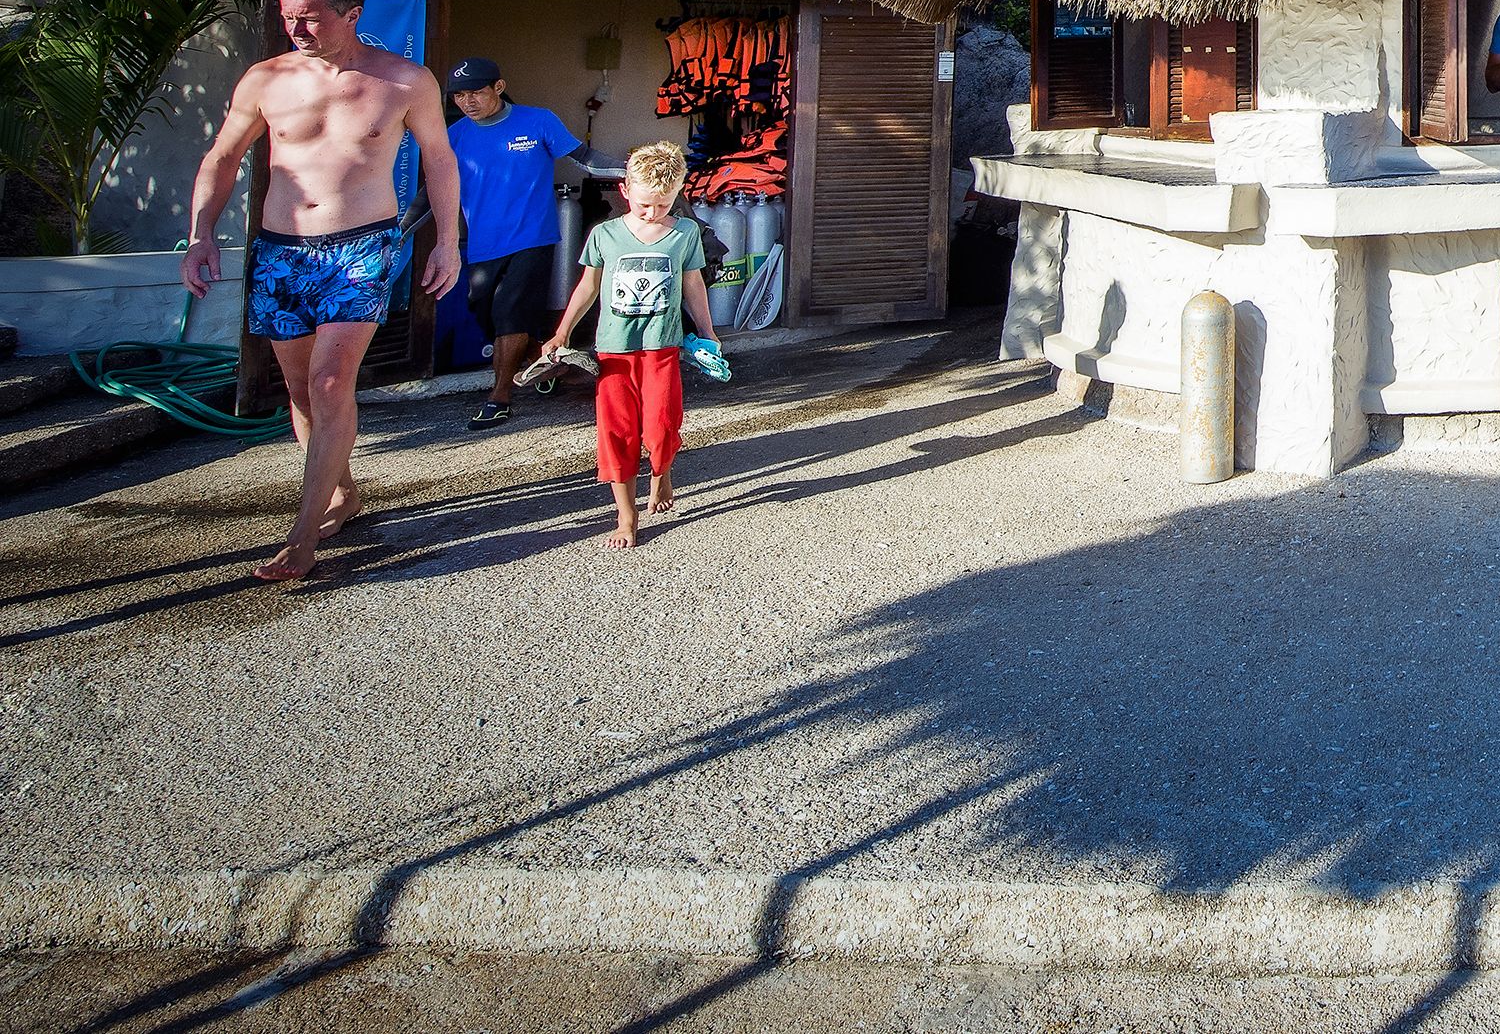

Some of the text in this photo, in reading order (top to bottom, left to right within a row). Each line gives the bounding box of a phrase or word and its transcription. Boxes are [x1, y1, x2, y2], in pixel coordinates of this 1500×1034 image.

[404, 34, 414, 58] Dive
[400, 152, 408, 170] the
[399, 174, 409, 197] Way
